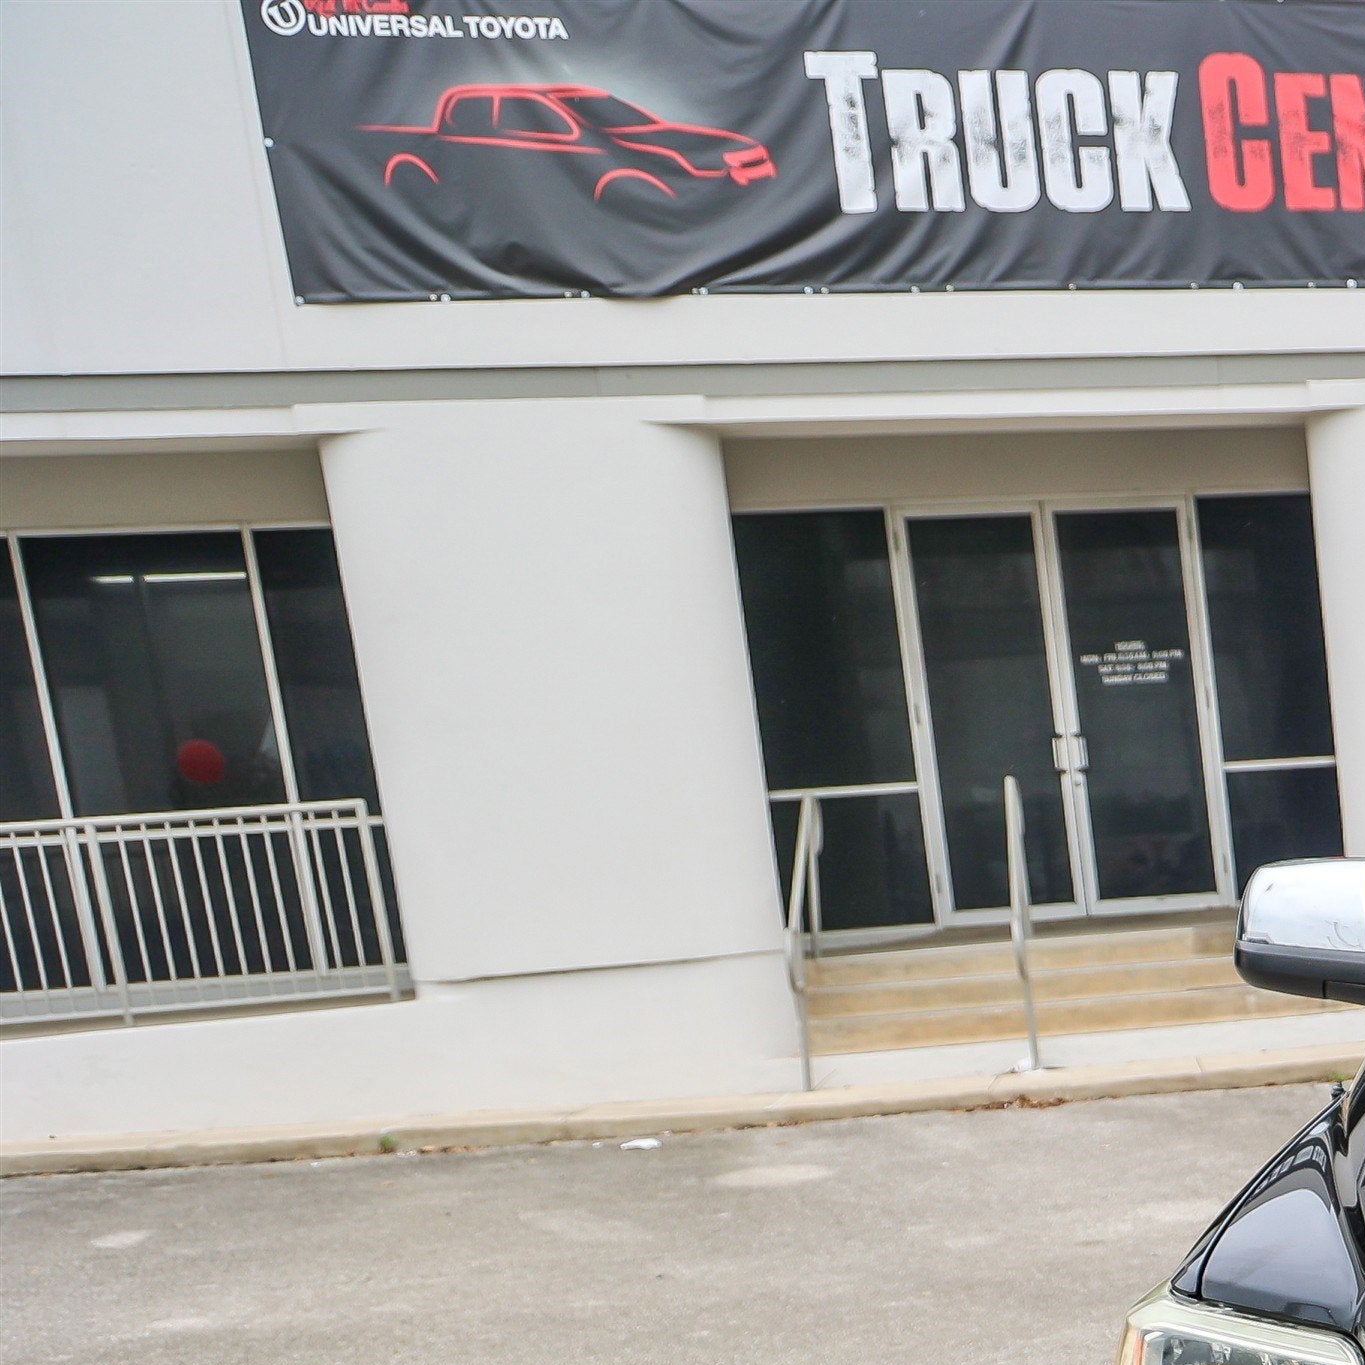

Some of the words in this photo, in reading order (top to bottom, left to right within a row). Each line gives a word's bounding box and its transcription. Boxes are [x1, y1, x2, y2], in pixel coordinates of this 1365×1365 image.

[307, 14, 463, 38] UNIVERSAL
[463, 16, 569, 40] TOYOTA
[803, 51, 1192, 215] TRUCK
